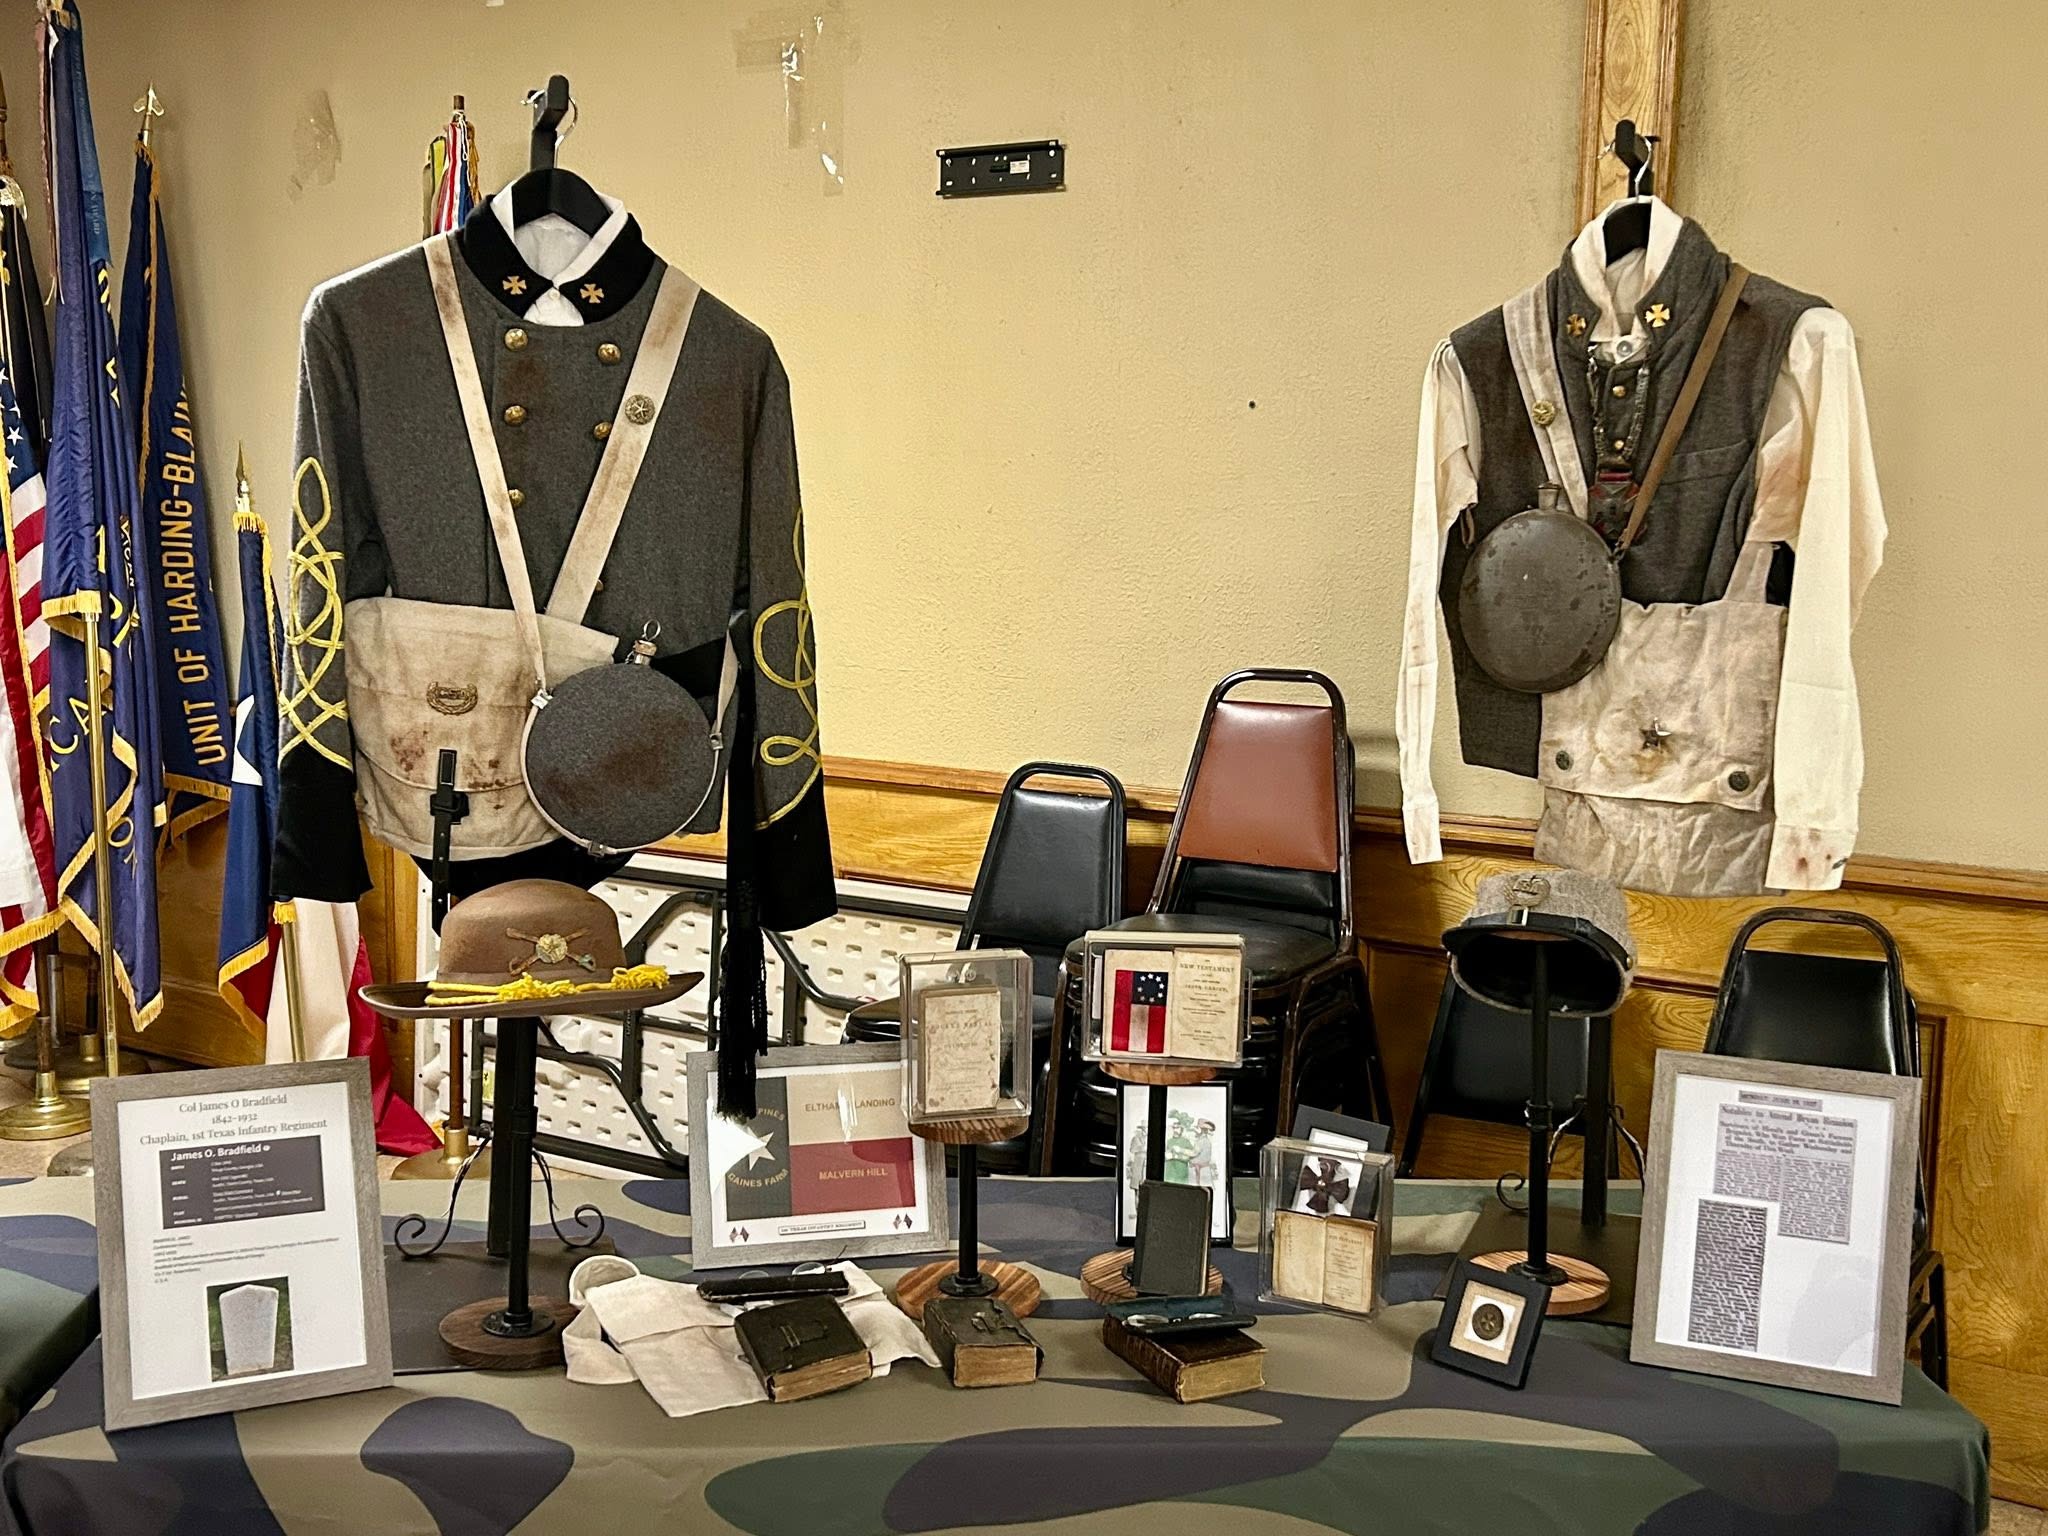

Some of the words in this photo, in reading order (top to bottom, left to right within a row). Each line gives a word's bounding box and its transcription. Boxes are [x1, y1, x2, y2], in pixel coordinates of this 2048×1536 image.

[174, 648, 209, 683] OF
[183, 700, 227, 765] UNIT
[1197, 965, 1235, 973] TESTAMENT
[179, 1102, 197, 1112] Col
[199, 1101, 229, 1112] James
[231, 1099, 240, 1108] O
[242, 1094, 288, 1107] Bradfield
[855, 1098, 895, 1108] LANDING
[212, 1112, 258, 1124] 1842-1932
[758, 1107, 785, 1120] PINES
[140, 1133, 189, 1146] Chaplain,
[192, 1131, 205, 1140] 1st
[207, 1129, 236, 1139] Texas
[238, 1123, 277, 1136] Infantry
[280, 1119, 327, 1132] Regiment
[171, 1149, 203, 1162] James
[204, 1149, 216, 1159] O.
[217, 1144, 262, 1157] Bradfield
[728, 1172, 762, 1187] GAINES
[765, 1168, 789, 1186] FARM
[819, 1169, 864, 1180] MALVERN
[866, 1167, 888, 1176] HILL
